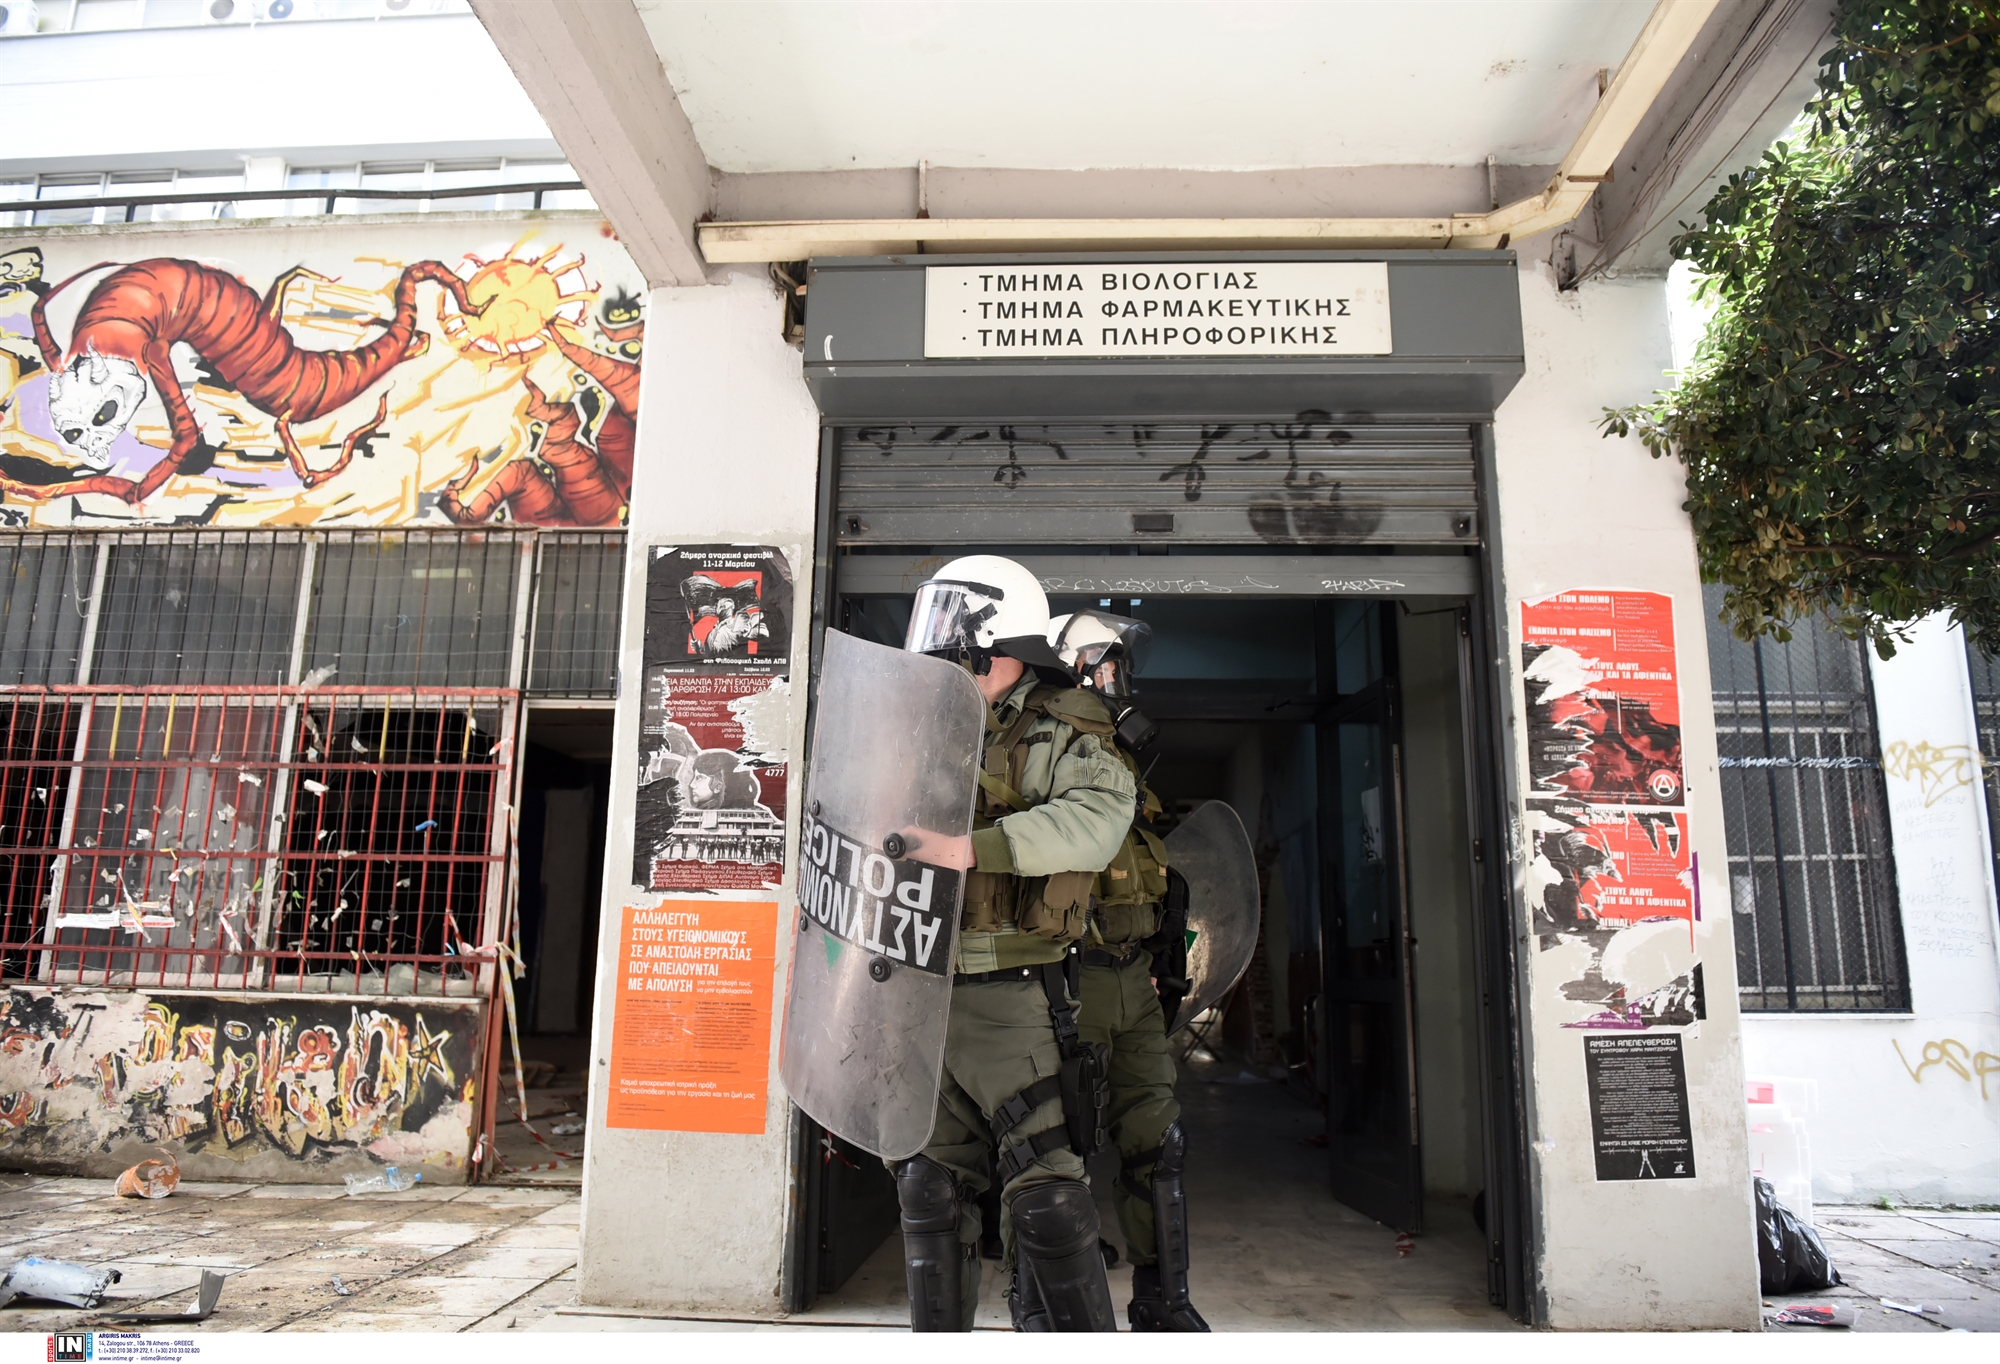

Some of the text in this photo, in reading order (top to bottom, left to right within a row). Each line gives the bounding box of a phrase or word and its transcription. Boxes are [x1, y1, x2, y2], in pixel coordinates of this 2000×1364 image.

[979, 272, 1259, 292] ΤΜΗΜΑ ΒΙΟΛΟΓΙΑΣ
[978, 298, 1352, 320] ΤΜΗΜΑ ΦΑΡΜΑΚΕΥΤΙΚΗΣ
[978, 325, 1339, 347] ΤΜΗΜΑ ΠΛΗΡΟΦΟΡΙΚΗΣ
[708, 551, 741, 560] αναρχικό
[703, 560, 756, 569] 11-12 Μαρτίου
[1559, 594, 1577, 603] ΣΤΟΝ
[1579, 595, 1610, 604] ΠΟΛΕΜΟ
[1528, 626, 1612, 637] ΕΝΑΝΤΙΑ ΣΤΟΝ ΦΑΣΙΣΜΟ
[1616, 662, 1640, 671] ΛΑΟΥΣ
[1606, 671, 1620, 679] ΚΑΙ
[1622, 671, 1631, 679] ΤΑ
[1633, 672, 1673, 681] ΑΦΕΝΤΙΚΑ
[680, 678, 771, 686] ΕΝΑΝΤΙΑ ΣΤΗΝ ΕΚΠΑΙΔΕΥ
[713, 686, 727, 694] 7/4
[764, 769, 785, 777] 4777
[803, 812, 935, 912] POLICE
[1605, 887, 1653, 896] ΣΤΟΥΣ ΛΑΟΥΣ
[1619, 897, 1633, 906] ΚΑΙ
[1635, 897, 1645, 906] ΤΑ
[1647, 898, 1687, 907] ΑΦΕΝΤΙΚΑ
[800, 853, 943, 968] ΑΣΤΥΝΟΜΙ
[632, 911, 699, 926] ΑΛΛΗΛΕΓΓΥΗ
[631, 927, 747, 945] ΣΤΟΥΣ ΥΓΕΙΟΝΟΜΙΚΟΥΣ
[630, 944, 752, 961] ΣΕ ΑΝΑΣΤΟΛΗ ΕΡΓΑΣΙΑΣ
[629, 961, 718, 977] ΠΟΥ ΑΠΕΙΛΟΥΝΤΑΙ
[628, 978, 693, 993] ΜΕ ΑΠΟΛΥΣΗ
[1589, 1038, 1676, 1048] ΑΜΕΣΗ ΑΠΕΛΕΥΘΕΡΩΣΗ
